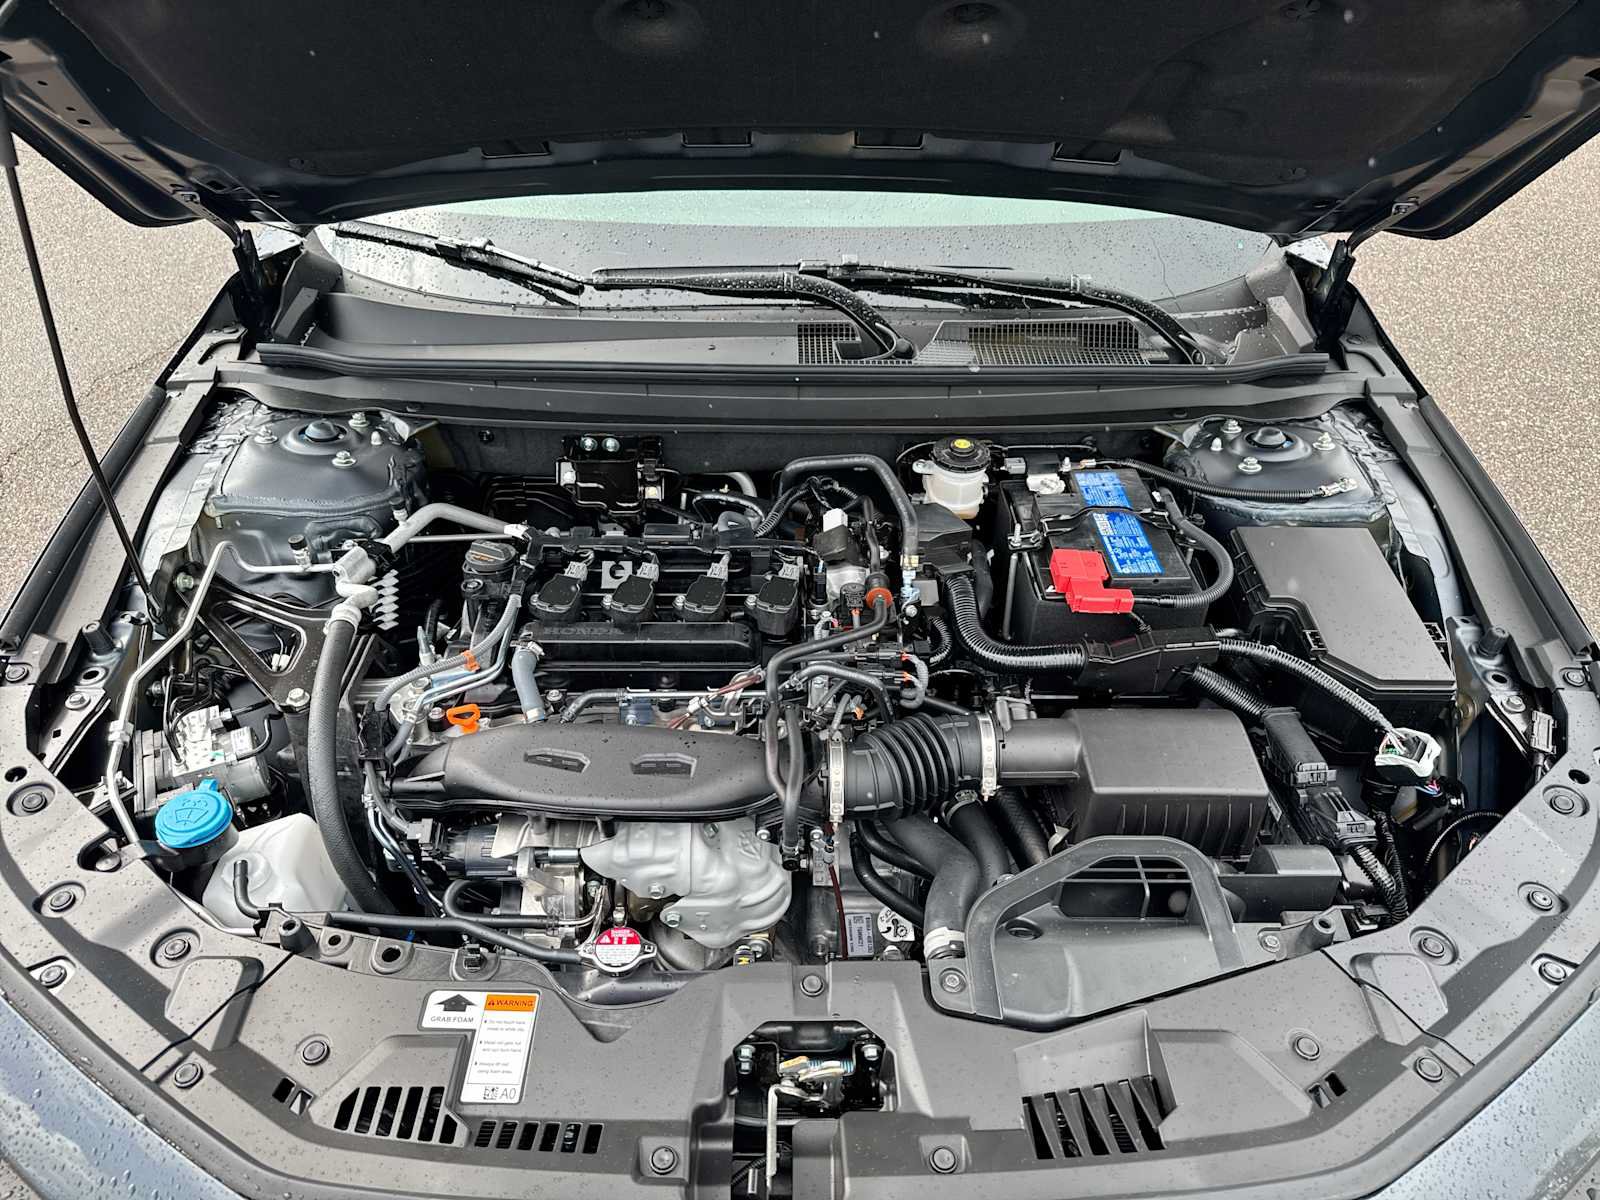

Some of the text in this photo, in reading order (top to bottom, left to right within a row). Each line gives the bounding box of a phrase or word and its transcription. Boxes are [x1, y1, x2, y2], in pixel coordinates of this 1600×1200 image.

[543, 626, 624, 635] HONDA
[496, 999, 534, 1007] WARNING
[430, 1015, 474, 1023] GRAB FOAM
